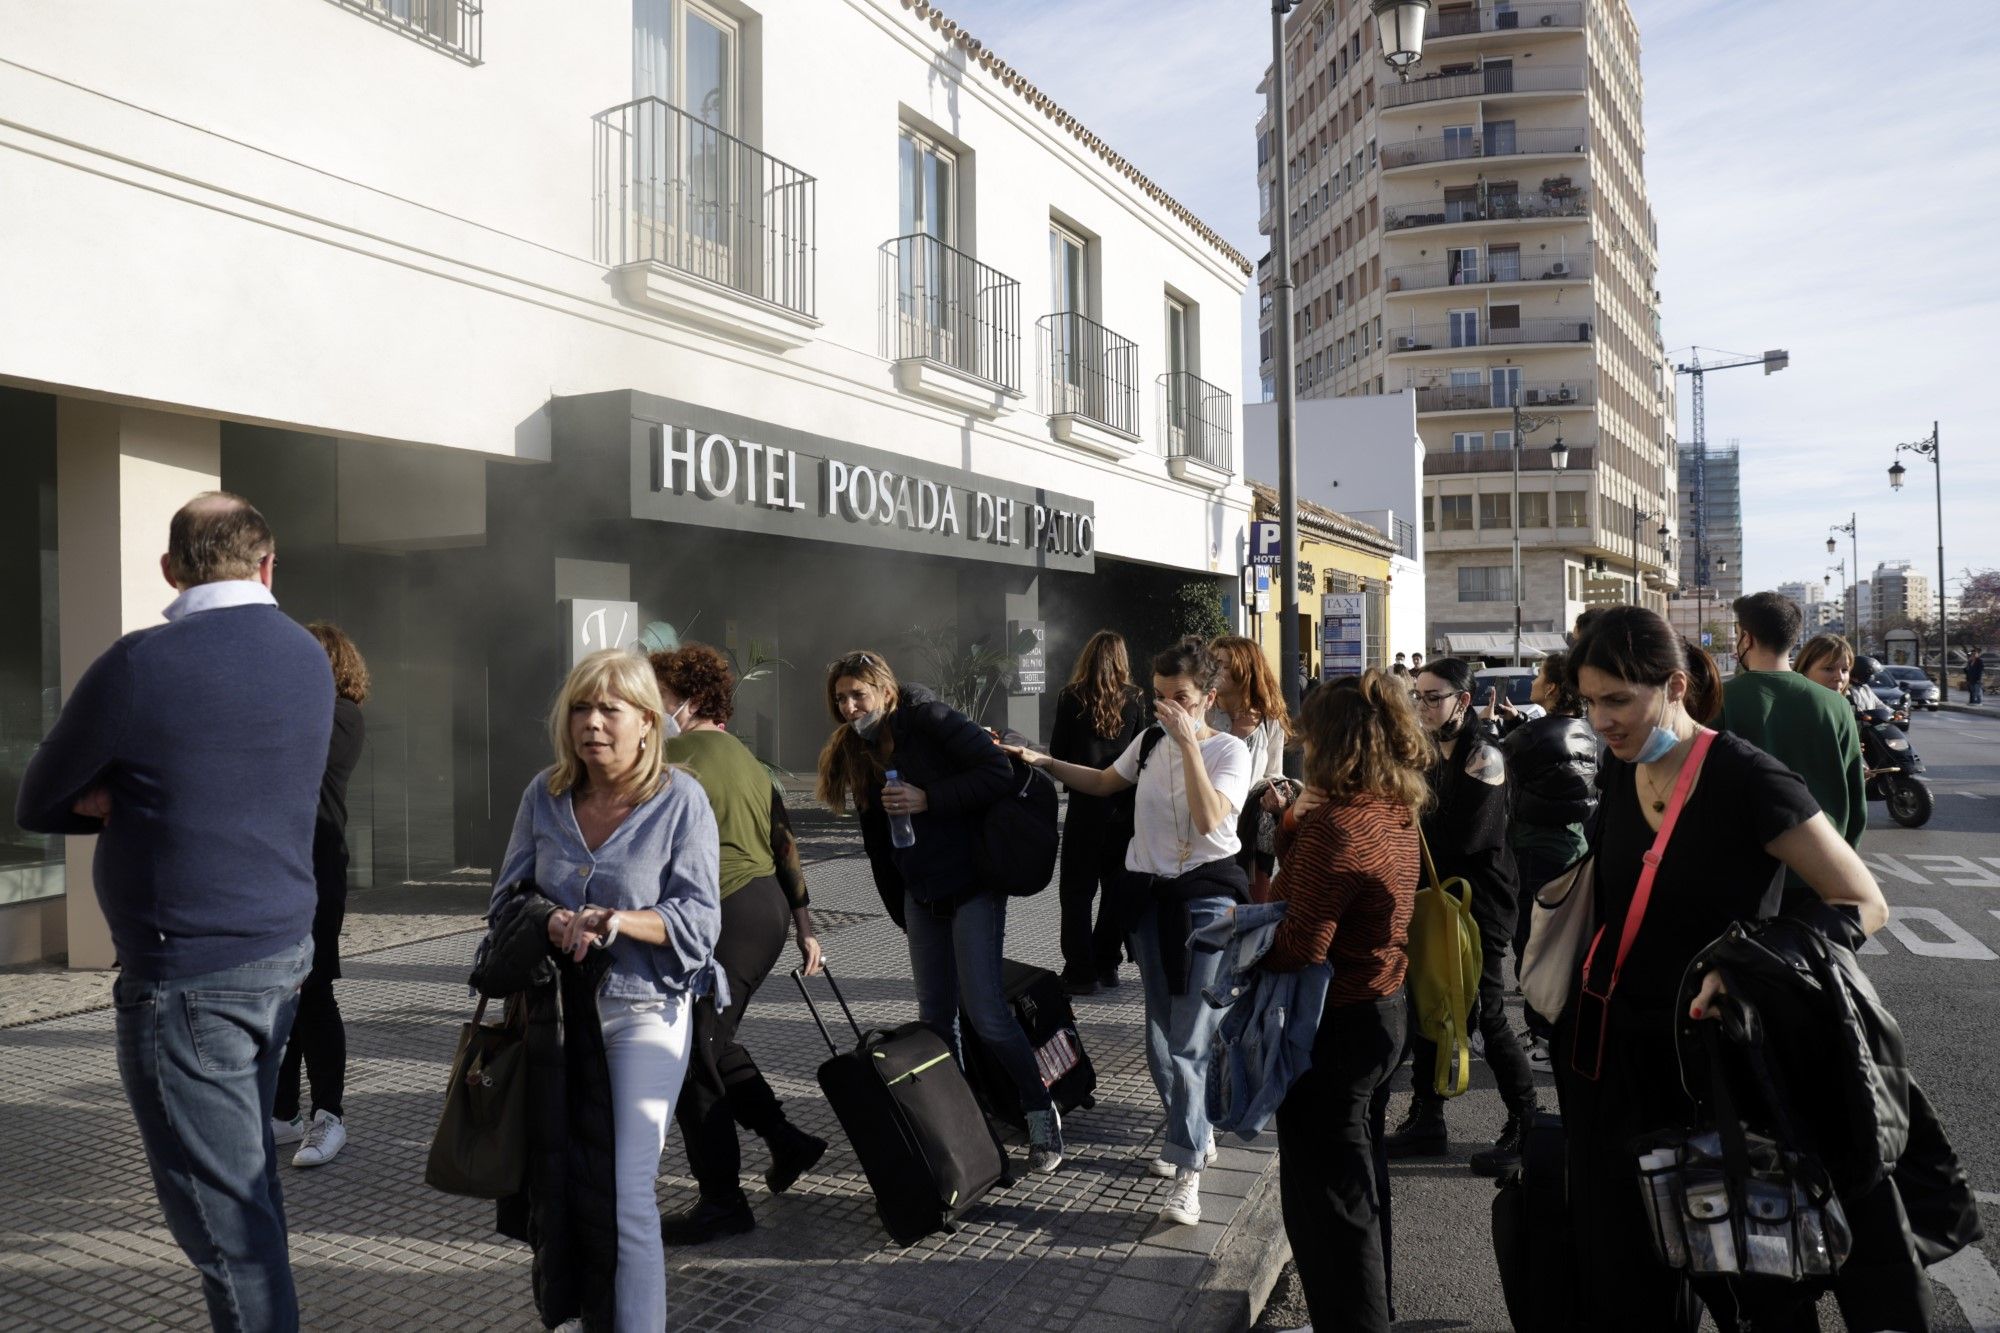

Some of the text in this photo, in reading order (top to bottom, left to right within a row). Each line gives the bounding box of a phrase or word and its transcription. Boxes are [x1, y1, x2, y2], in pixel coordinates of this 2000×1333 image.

[663, 423, 1095, 556] HOTEL POSADA DEL PATIO
[1260, 523, 1281, 553] P
[1253, 555, 1281, 564] HOTE
[1326, 598, 1360, 608] TAXI
[1024, 673, 1040, 682] HOTEL
